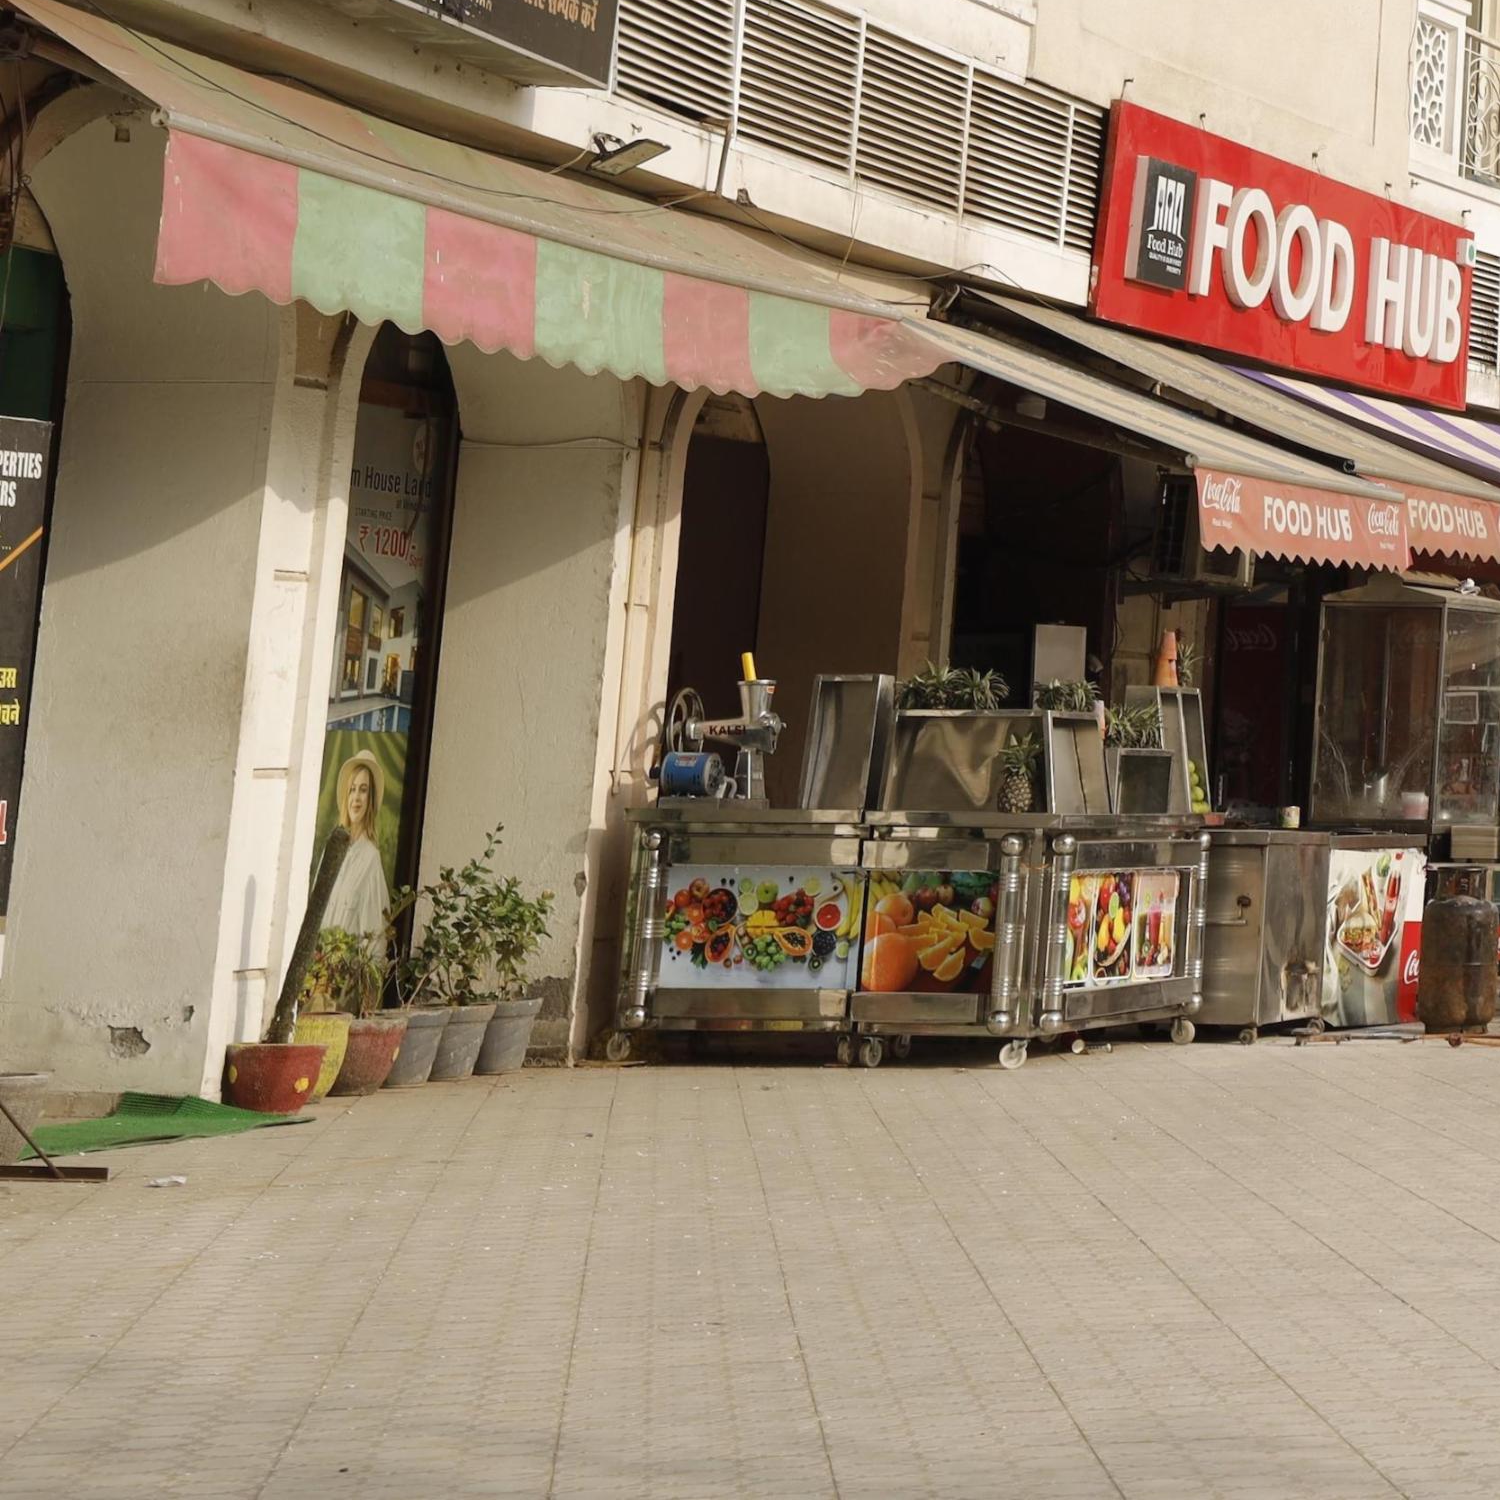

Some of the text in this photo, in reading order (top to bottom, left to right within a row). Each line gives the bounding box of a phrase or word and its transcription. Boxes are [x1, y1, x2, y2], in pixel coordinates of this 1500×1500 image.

[1147, 233, 1184, 258] Food Hub
[1188, 178, 1462, 363] FOOD HUB
[365, 466, 401, 494] House
[1202, 473, 1242, 514] Coca-Cola
[1263, 495, 1353, 542] FOOD HUB
[1367, 502, 1399, 536] Coca-Cola
[1407, 498, 1488, 539] FOOD HUB
[709, 725, 746, 736] KALSI
